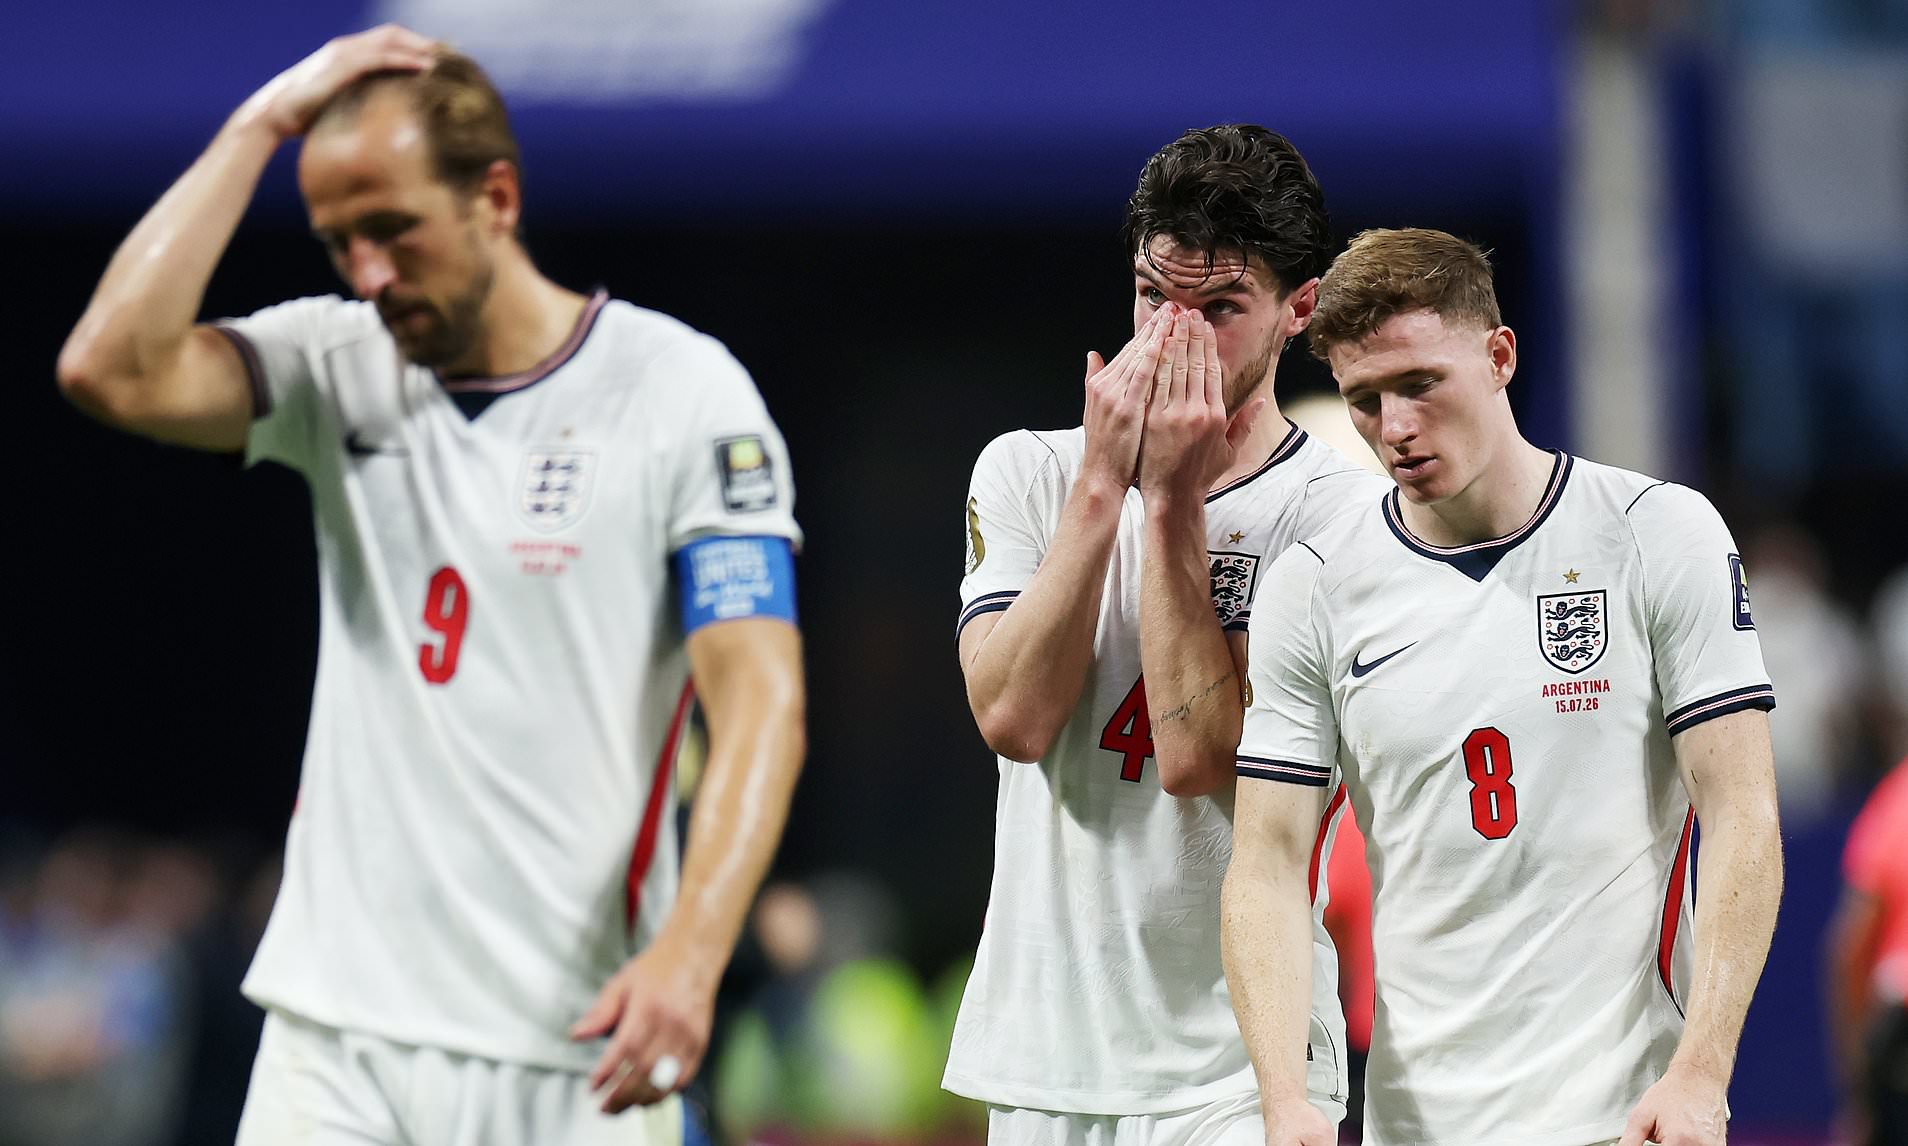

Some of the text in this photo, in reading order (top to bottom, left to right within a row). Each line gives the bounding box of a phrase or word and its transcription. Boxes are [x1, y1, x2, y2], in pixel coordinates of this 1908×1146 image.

[418, 565, 469, 684] 9
[1099, 671, 1154, 783] 4
[1542, 680, 1610, 698] ARGENTINA
[1555, 697, 1599, 713] 15.07.26
[1462, 726, 1518, 840] 8
